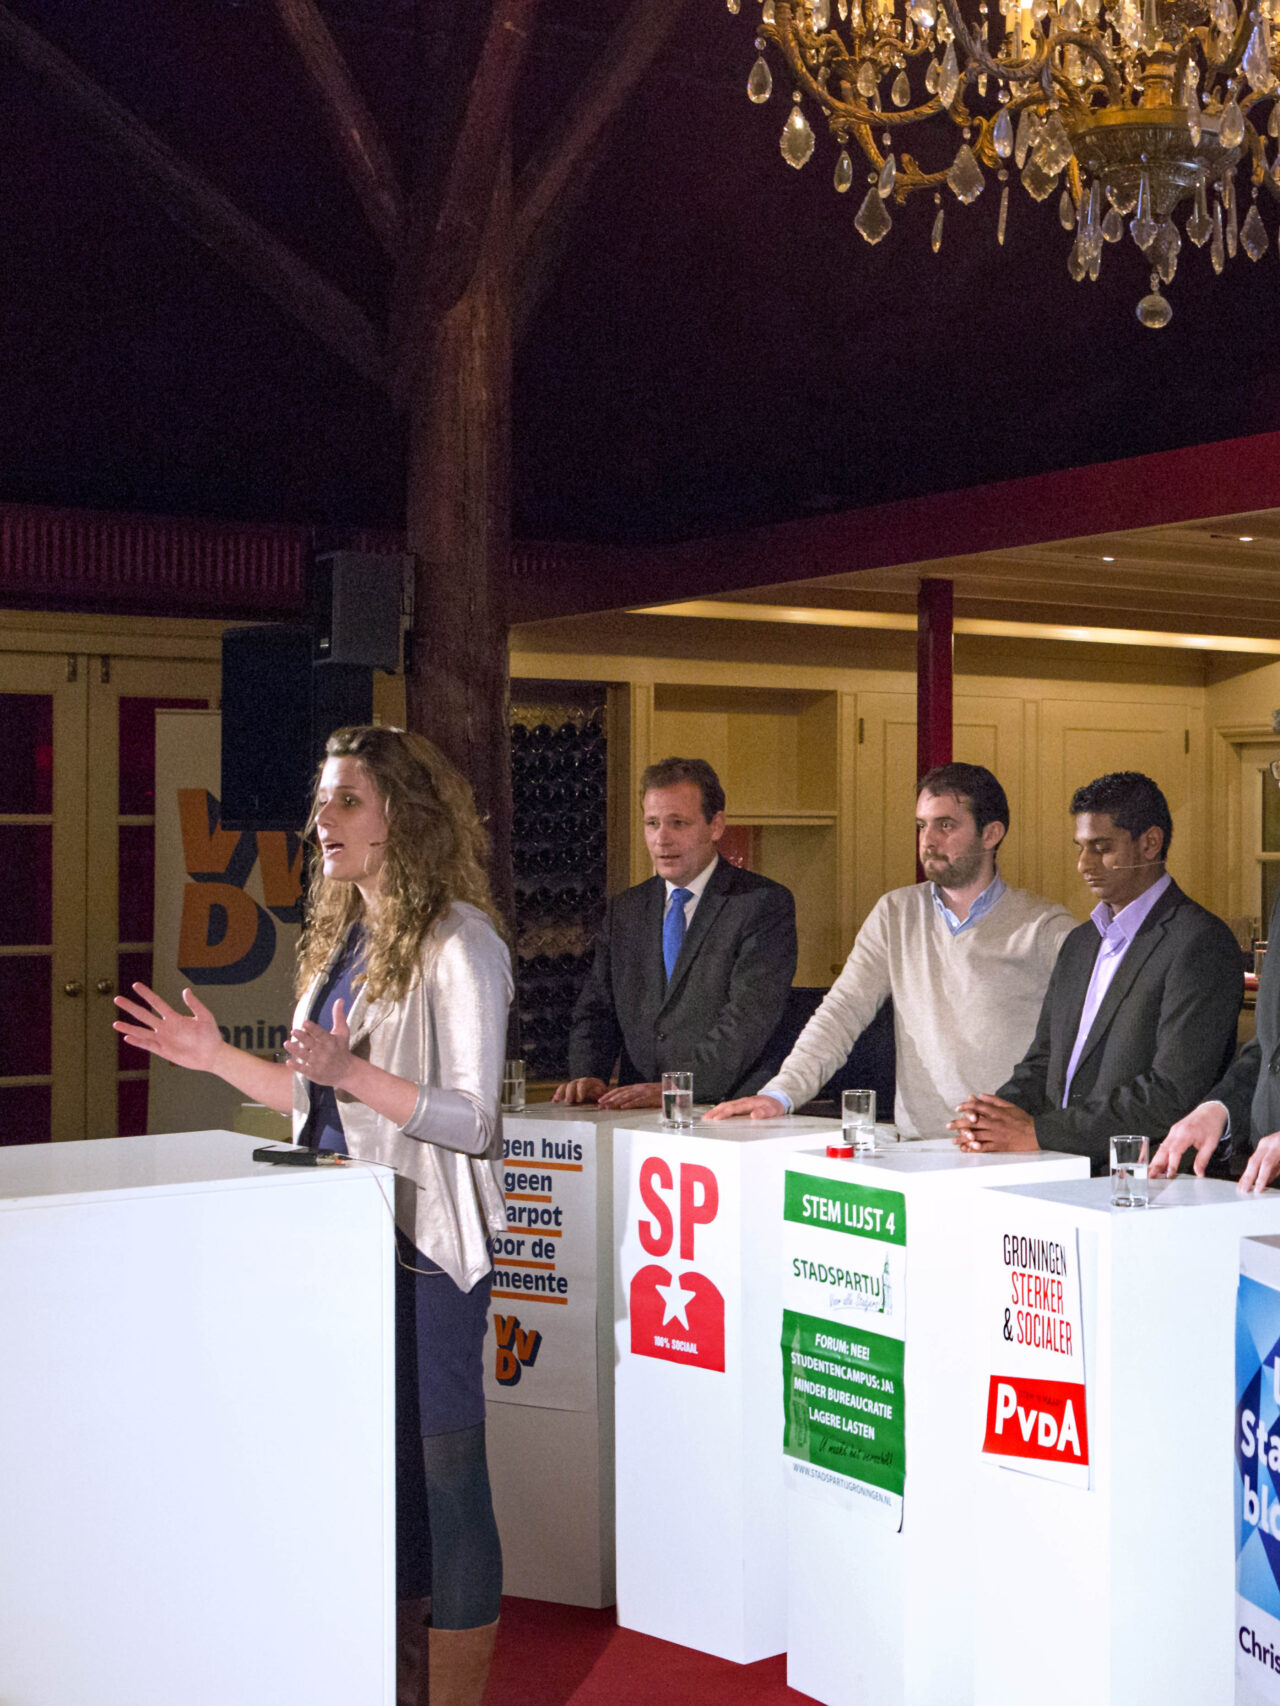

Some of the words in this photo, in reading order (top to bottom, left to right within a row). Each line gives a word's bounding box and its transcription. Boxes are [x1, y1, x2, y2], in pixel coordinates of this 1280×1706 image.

[541, 1138, 583, 1161] huis
[504, 1171, 552, 1193] geen
[638, 1156, 719, 1261] SP
[802, 1193, 842, 1224] STEM
[844, 1202, 884, 1233] LIJST
[885, 1212, 896, 1235] 4
[531, 1238, 556, 1260] de
[1003, 1233, 1067, 1278] GRONINGEN
[792, 1257, 881, 1297] STADSPARTIJ
[1011, 1270, 1064, 1315] STERKER
[494, 1314, 542, 1386] VVD
[815, 1333, 849, 1355] FORUM:
[850, 1343, 870, 1361] NEE!
[1003, 1307, 1014, 1342] &
[1016, 1309, 1073, 1356] SOCIALER
[790, 1352, 880, 1390] STUDENTENCAMPUS:
[880, 1378, 895, 1394] JA!
[793, 1377, 827, 1399] MINDER
[827, 1388, 893, 1420] BUREAUCRATIE
[808, 1407, 841, 1429] LAGERE
[842, 1417, 875, 1440] LASTEN
